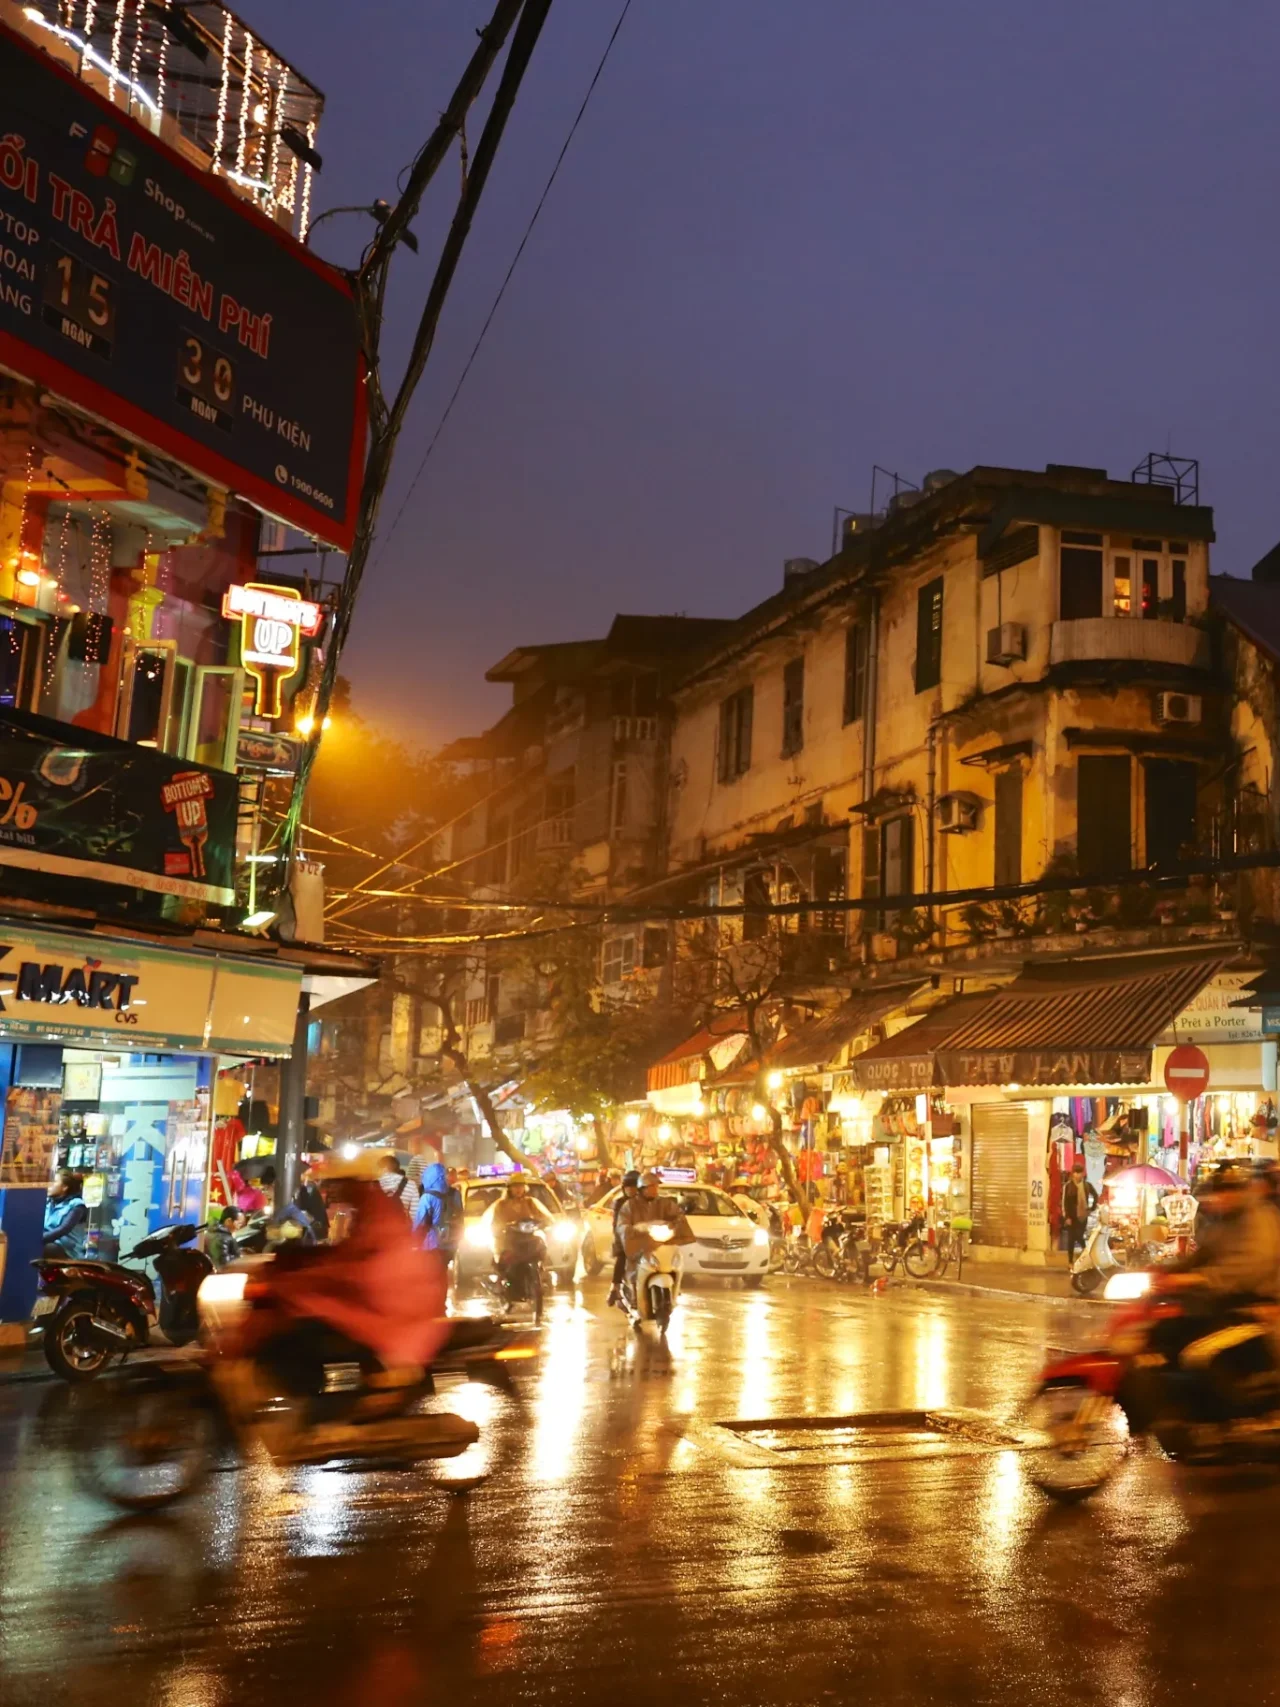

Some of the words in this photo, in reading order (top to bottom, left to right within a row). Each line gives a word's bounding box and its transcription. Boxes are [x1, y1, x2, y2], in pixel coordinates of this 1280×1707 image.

[145, 178, 186, 220] Shop
[48, 171, 121, 262] TRẢ
[219, 293, 273, 361] PHÍ
[254, 618, 293, 654] UP
[181, 801, 200, 826] UP
[115, 1011, 138, 1024] CVS
[1181, 1018, 1201, 1029] Prêt
[1214, 1016, 1246, 1027] Porter
[1031, 1180, 1043, 1197] 26
